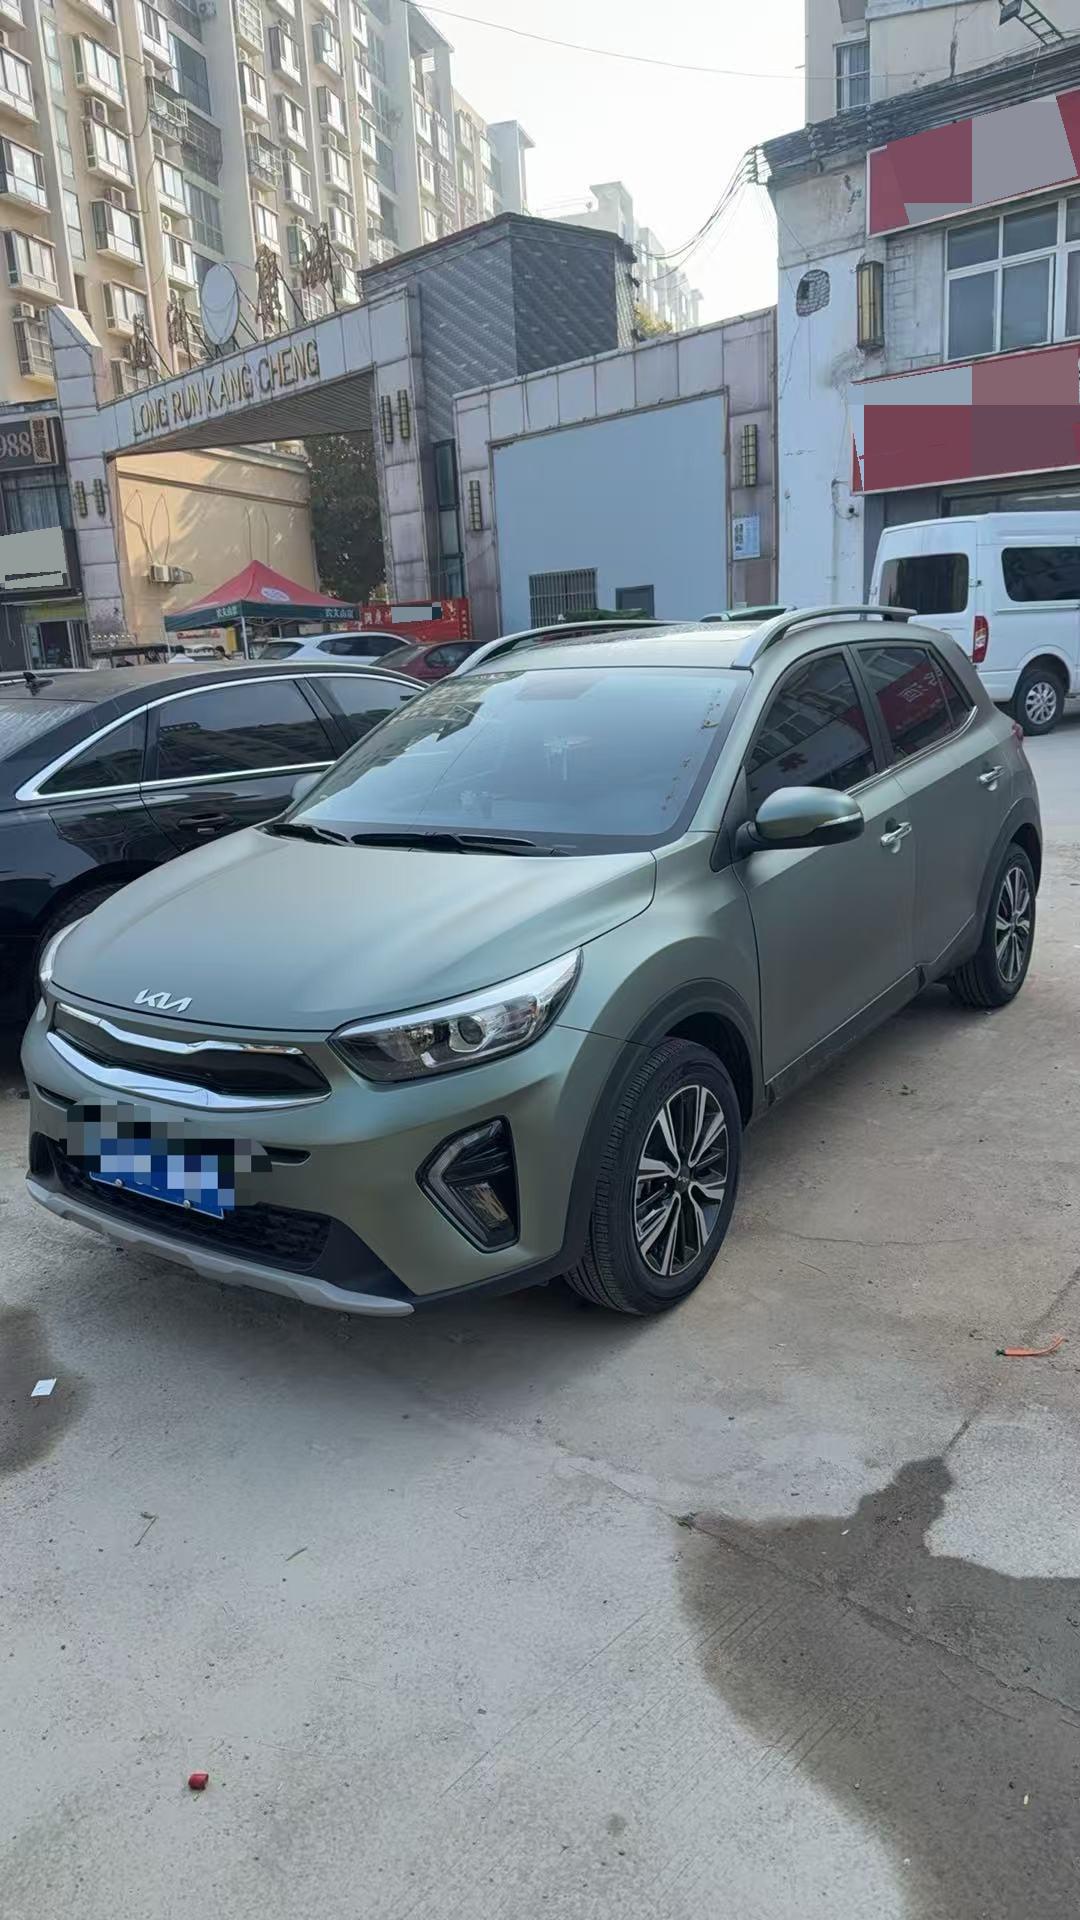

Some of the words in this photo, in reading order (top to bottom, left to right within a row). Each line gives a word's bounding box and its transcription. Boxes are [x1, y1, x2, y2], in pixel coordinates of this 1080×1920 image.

[131, 395, 170, 437] LONG
[172, 383, 203, 425] RUN
[205, 363, 254, 413] KANG
[257, 340, 320, 394] CHENG
